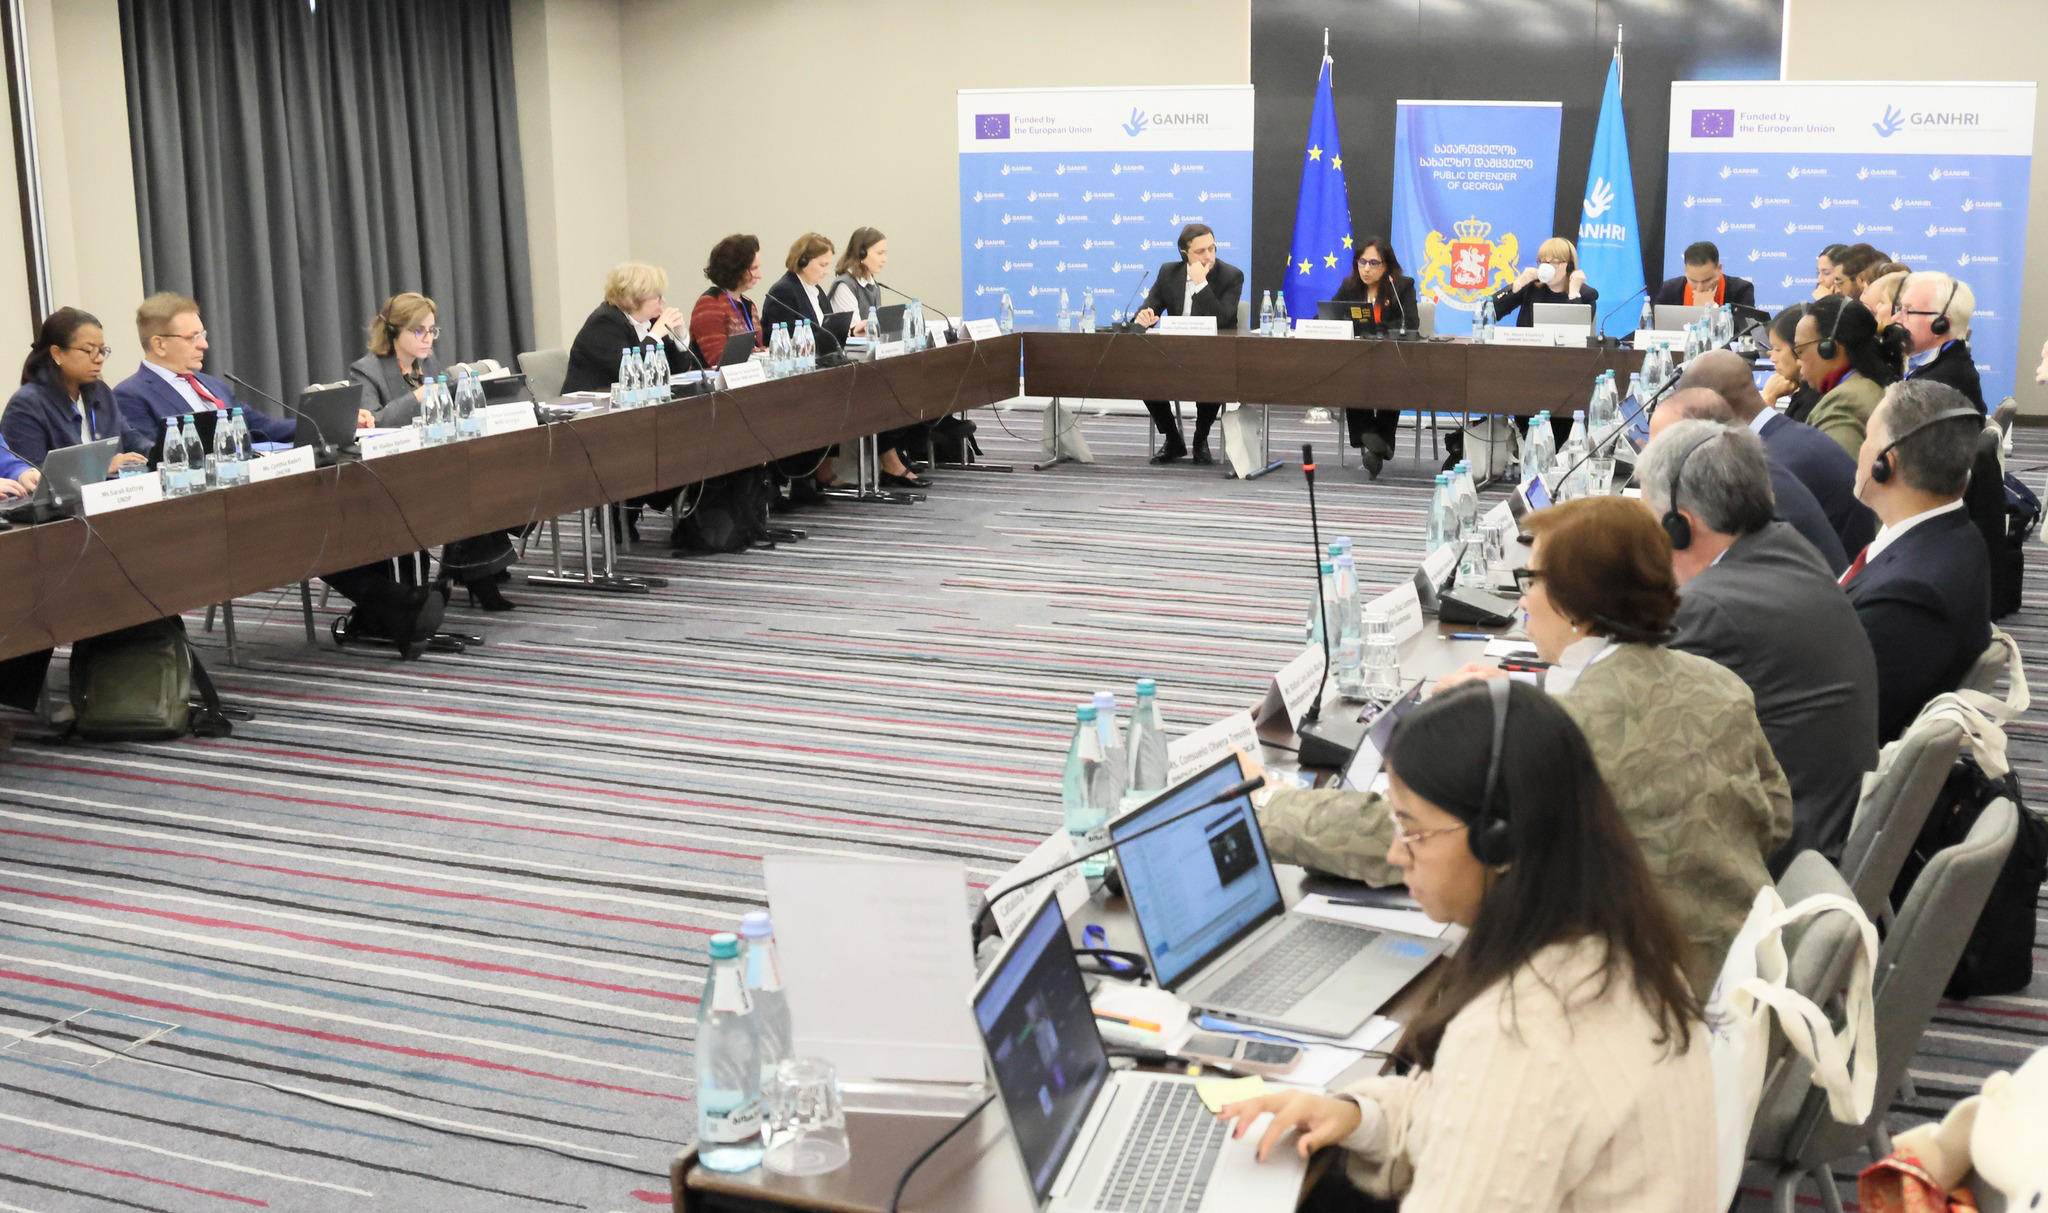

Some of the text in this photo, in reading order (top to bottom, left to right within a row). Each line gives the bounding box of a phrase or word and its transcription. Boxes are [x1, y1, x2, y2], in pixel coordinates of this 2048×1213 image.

[1014, 116, 1056, 125] Funded by
[1152, 113, 1209, 125] GANHRI
[1740, 112, 1791, 123] Funded by
[1910, 112, 1980, 126] GANHRI
[1014, 126, 1092, 136] the European Union
[1739, 124, 1835, 135] the European Union
[1433, 170, 1517, 181] PUBLIC DEFENDER
[1447, 181, 1504, 191] OF GEORGIA
[1832, 198, 1859, 206] GANHRI
[1975, 200, 2002, 208] GANHRI
[1579, 222, 1626, 242] ANHRI
[1939, 226, 1966, 234] GANHRI
[1971, 255, 1998, 263] GANHRI
